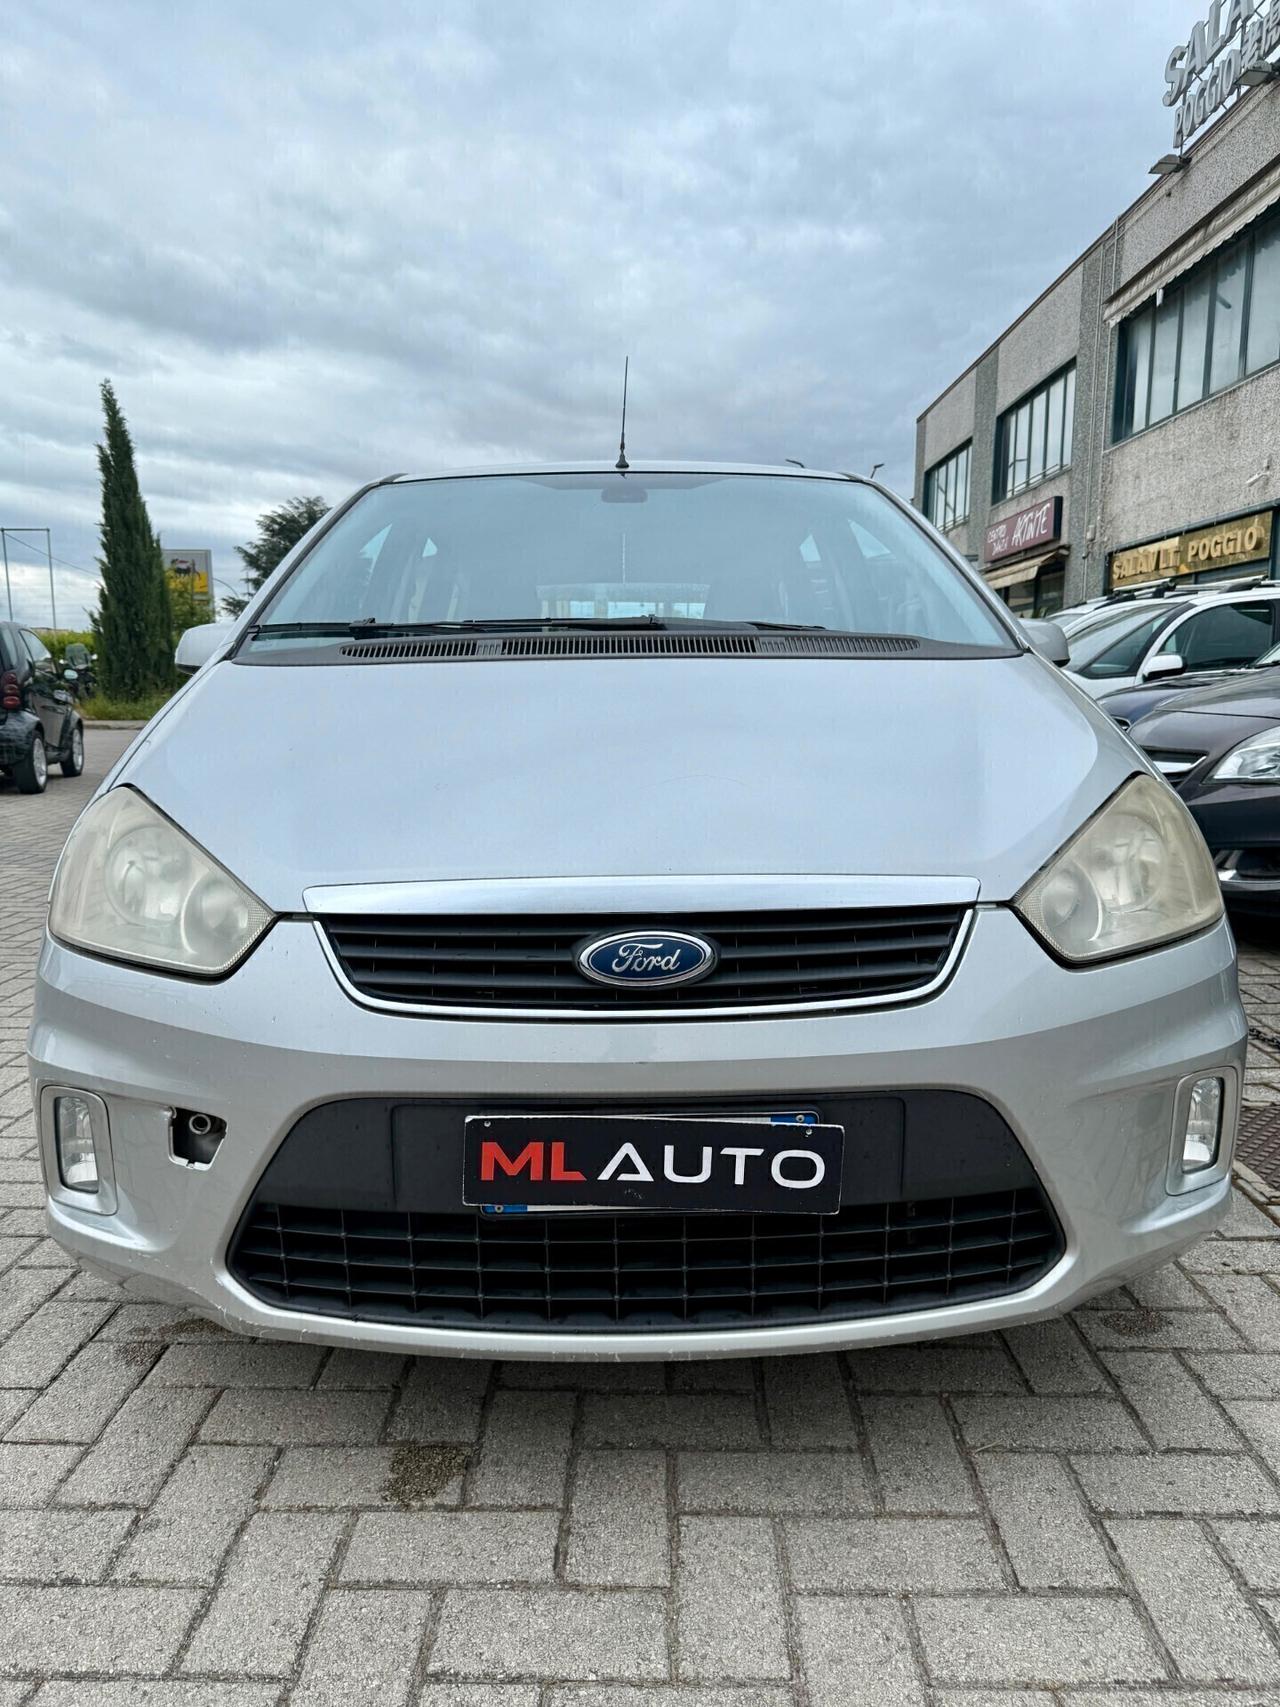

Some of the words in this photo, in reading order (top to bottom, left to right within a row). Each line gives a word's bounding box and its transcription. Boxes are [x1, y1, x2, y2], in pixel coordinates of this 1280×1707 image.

[1173, 49, 1241, 148] POGGIO
[1187, 526, 1258, 563] POGGIO
[611, 943, 681, 973] Ford
[480, 1141, 587, 1182] ML
[596, 1141, 826, 1189] AUTO
